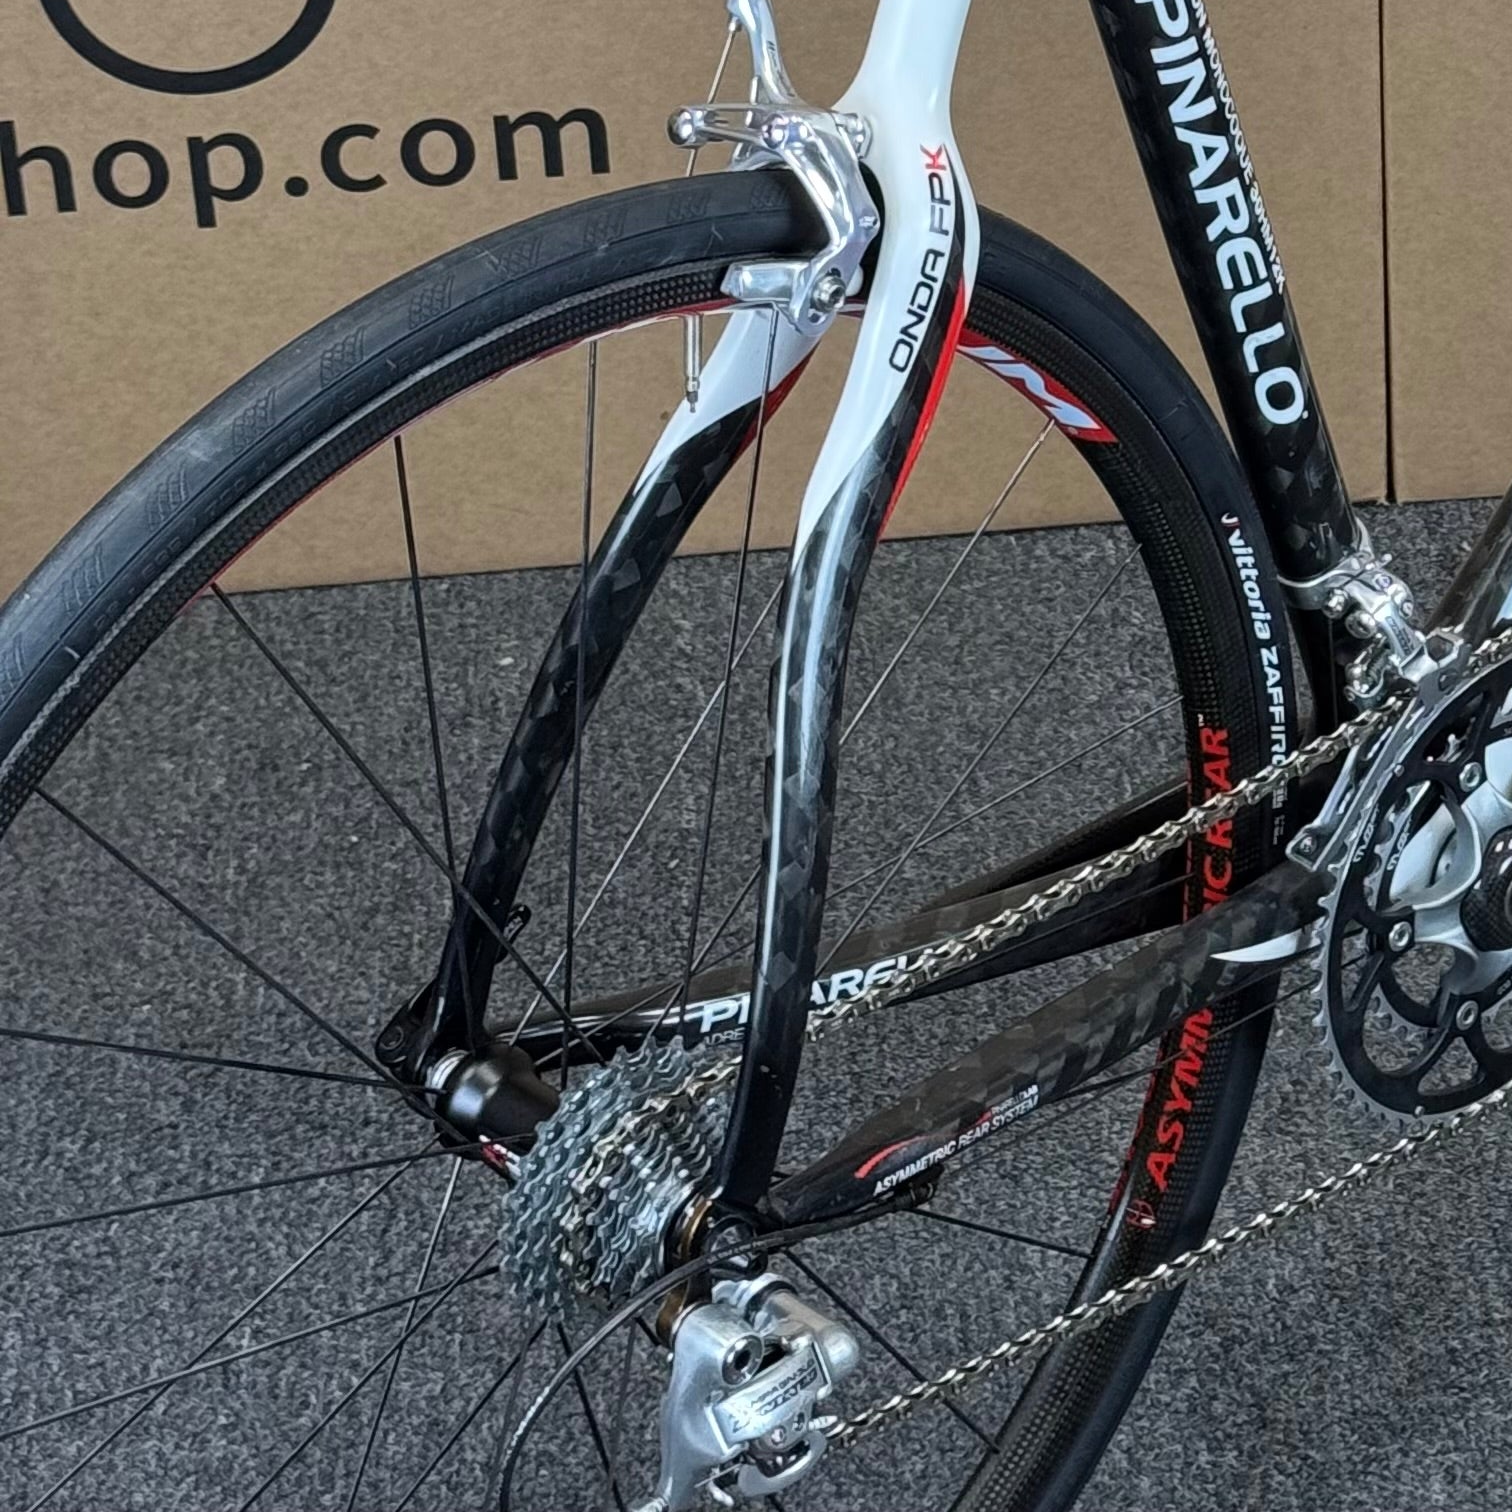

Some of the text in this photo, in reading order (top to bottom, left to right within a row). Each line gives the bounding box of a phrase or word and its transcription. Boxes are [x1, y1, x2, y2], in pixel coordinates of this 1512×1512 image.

[888, 143, 951, 373] ONDA FPK
[872, 1139, 957, 1197] ASYMMETRIC
[956, 1120, 991, 1150] REAR
